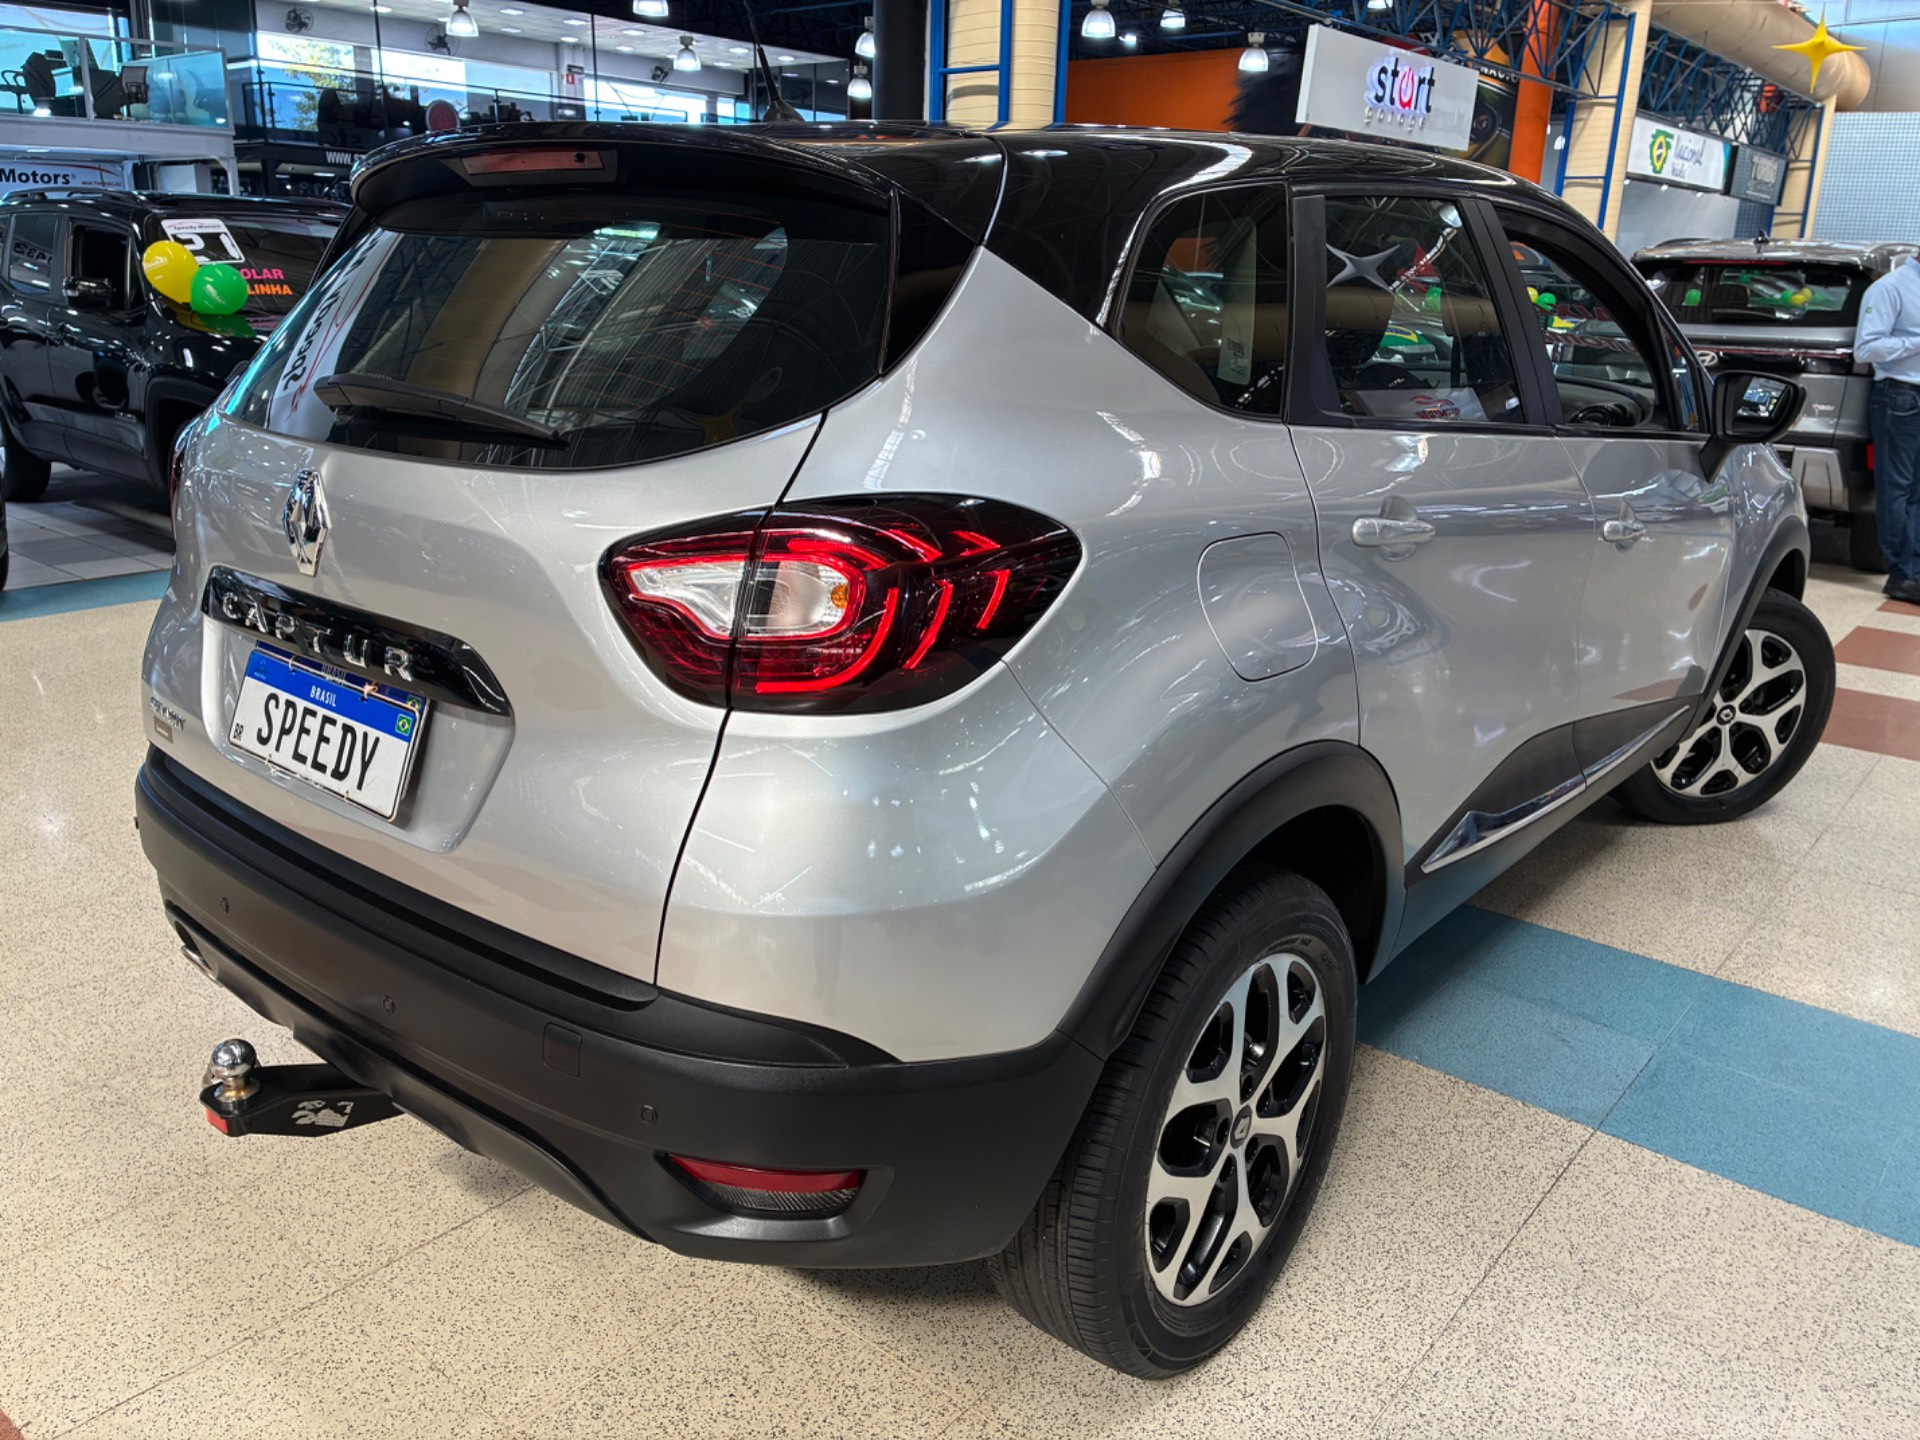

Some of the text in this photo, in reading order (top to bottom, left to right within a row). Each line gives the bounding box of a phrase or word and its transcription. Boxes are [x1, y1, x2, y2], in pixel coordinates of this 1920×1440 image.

[0, 168, 71, 185] Motors
[239, 268, 285, 280] OLAR
[247, 284, 293, 296] LINHA
[222, 591, 413, 682] CAPTUR
[309, 685, 337, 708] BRASIL
[232, 722, 244, 742] BR
[256, 692, 380, 791] SPEEDY
